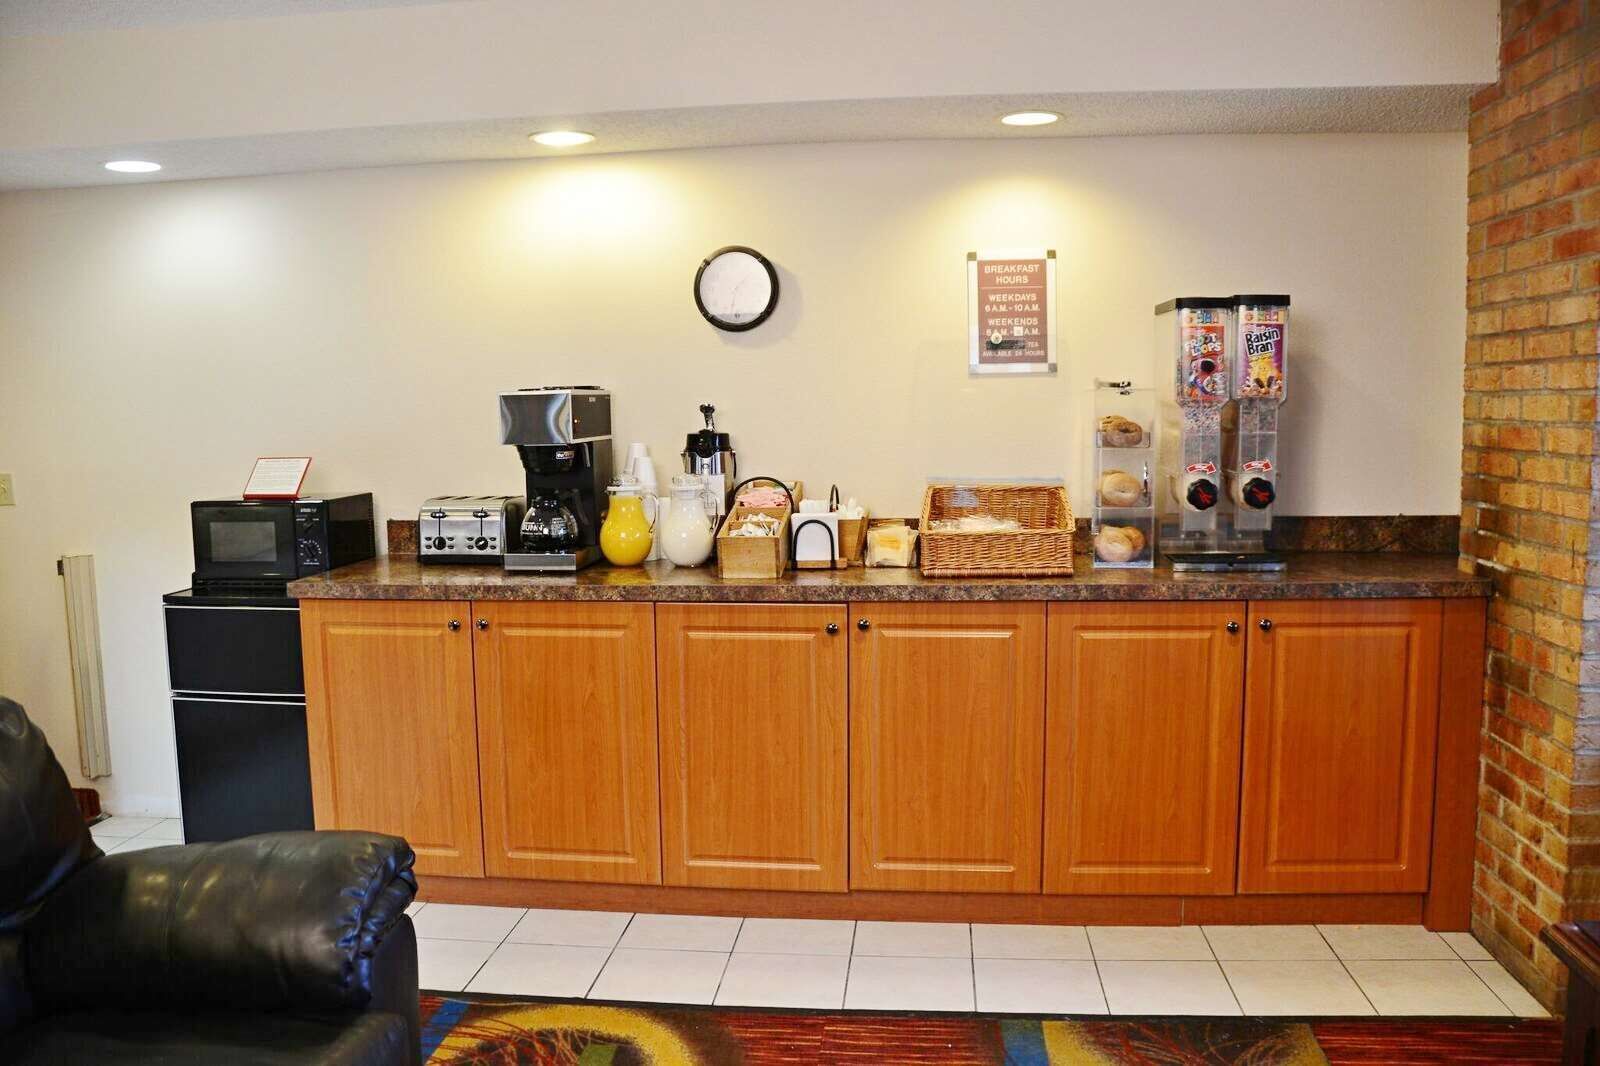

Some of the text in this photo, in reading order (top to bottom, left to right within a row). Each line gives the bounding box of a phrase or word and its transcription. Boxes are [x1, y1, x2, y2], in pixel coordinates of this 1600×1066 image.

[984, 264, 1040, 273] BREAKFAST
[996, 276, 1029, 284] HOURS
[989, 294, 1037, 302] WEEKDAYS
[992, 304, 1009, 312] A.M.
[1014, 304, 1023, 312] 10
[1024, 304, 1040, 312] A.M.
[988, 318, 1038, 326] WEEKENDS
[1245, 327, 1279, 345] Raisin
[1247, 341, 1274, 356] Bran
